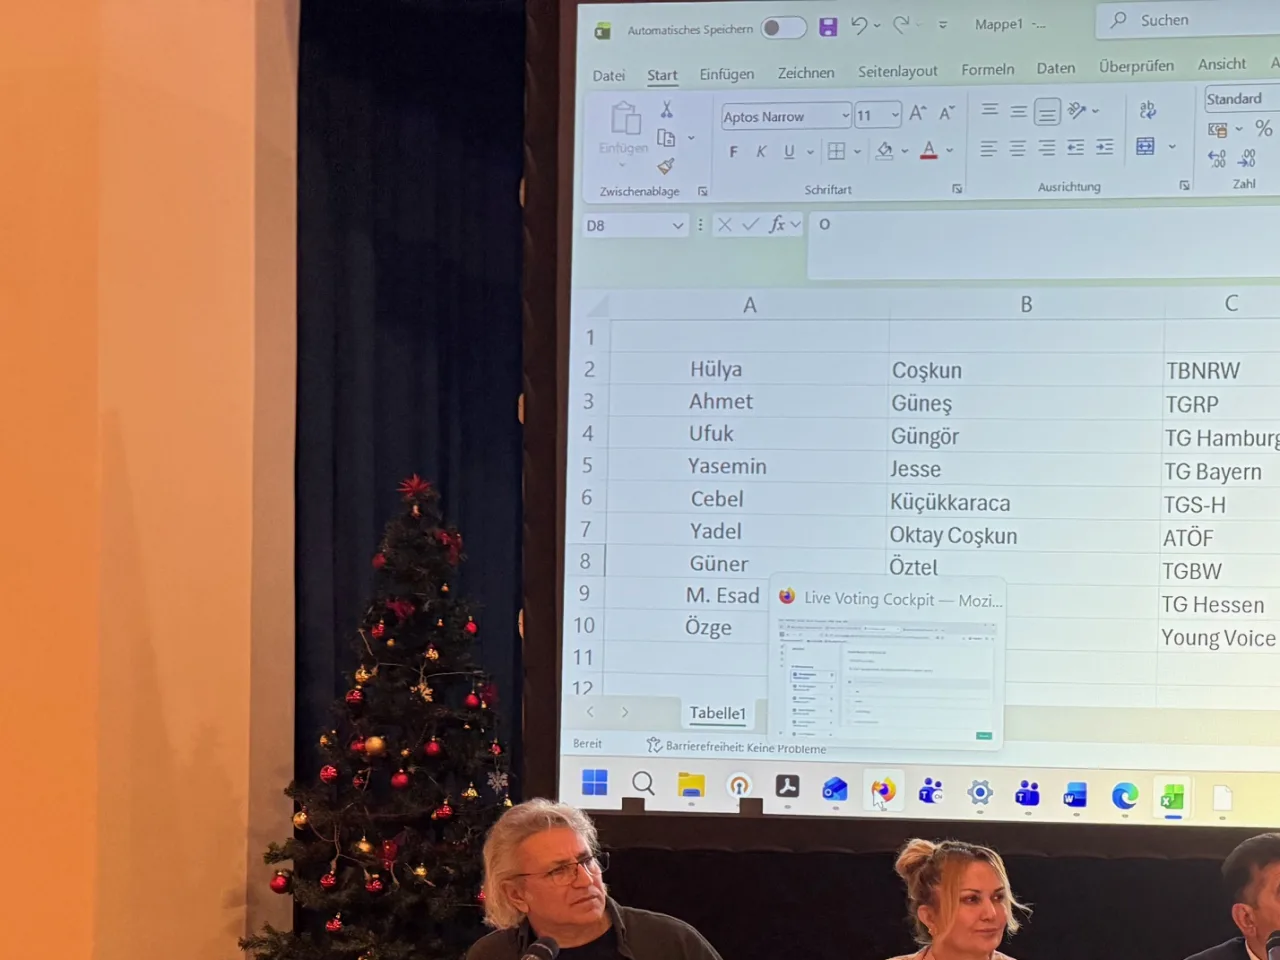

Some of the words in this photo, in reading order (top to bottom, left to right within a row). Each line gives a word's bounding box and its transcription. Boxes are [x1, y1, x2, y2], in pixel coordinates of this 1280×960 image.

[975, 19, 1022, 32] Mappe1
[1141, 14, 1188, 26] Suchen
[627, 25, 700, 35] Automatisches
[703, 24, 753, 37] Speichern
[592, 69, 625, 81] Datei
[647, 70, 677, 81] Start
[700, 68, 754, 83] Einfügen
[777, 67, 834, 79] Zeichnen
[858, 65, 938, 80] Seitenlayout
[961, 63, 1014, 75] Formeln
[1037, 63, 1075, 74] Daten
[1099, 59, 1174, 76] Überprüfen
[1197, 57, 1246, 70] Ansicht
[1206, 92, 1262, 105] Standard
[723, 112, 759, 125] Aptos
[762, 112, 804, 122] Narrow
[858, 110, 870, 121] 11
[599, 142, 648, 156] Einfügen
[730, 146, 738, 157] F
[756, 145, 766, 157] K
[784, 145, 795, 157] U
[804, 184, 852, 195] Schriftart
[1037, 181, 1101, 194] Ausrichtung
[1232, 179, 1255, 189] Zahl
[599, 186, 680, 199] Zwischenablage
[586, 220, 604, 231] D8
[743, 297, 757, 313] A
[1022, 296, 1032, 312] B
[1224, 295, 1238, 311] C
[587, 329, 593, 345] 1
[585, 361, 595, 377] 2
[691, 360, 741, 381] Hülya
[892, 362, 961, 383] Coşkun
[1166, 362, 1240, 379] TBNRW
[584, 393, 593, 409] 3
[688, 392, 753, 409] Ahmet
[891, 394, 952, 416] Güneş
[1165, 396, 1218, 413] TGRP
[583, 425, 593, 441] 4
[689, 424, 733, 441] Ufuk
[891, 427, 959, 449] Güngör
[1164, 429, 1191, 446] TG
[583, 457, 592, 473] 5
[687, 458, 766, 474] Yasemin
[890, 460, 941, 477] Jesse
[1164, 463, 1190, 480] TG
[1196, 463, 1261, 484] Bayern
[582, 489, 592, 505] 6
[691, 490, 743, 507] Cebel
[890, 492, 1010, 514] Küçükkaraca
[1163, 496, 1225, 513] TGS-H
[581, 521, 591, 537] 7
[690, 522, 741, 539] Yadel
[890, 526, 943, 547] Oktay
[947, 527, 1017, 548] Coşkun
[1162, 525, 1213, 546] ATÖF
[580, 553, 590, 569] 8
[690, 555, 749, 572] Güner
[889, 554, 938, 576] Öztel
[1162, 563, 1222, 579] TGBW
[580, 585, 589, 601] 9
[686, 587, 709, 602] M.
[717, 587, 759, 603] Esad
[805, 590, 830, 604] Live
[834, 592, 878, 608] Voting
[883, 593, 934, 610] Cockpit
[958, 594, 1002, 607] Mozi...
[1161, 596, 1187, 612] TG
[1193, 596, 1264, 613] Hessen
[574, 617, 595, 633] 10
[685, 615, 731, 639] Özge
[1161, 629, 1220, 650] Young
[1223, 630, 1276, 646] Voice
[573, 649, 591, 665] 11
[571, 681, 593, 695] 12
[689, 706, 745, 719] Tabelle1
[573, 738, 602, 748] Bereit
[666, 741, 744, 752] Barrierefreiheit:
[747, 743, 775, 752] Keine
[777, 745, 826, 754] Probleme
